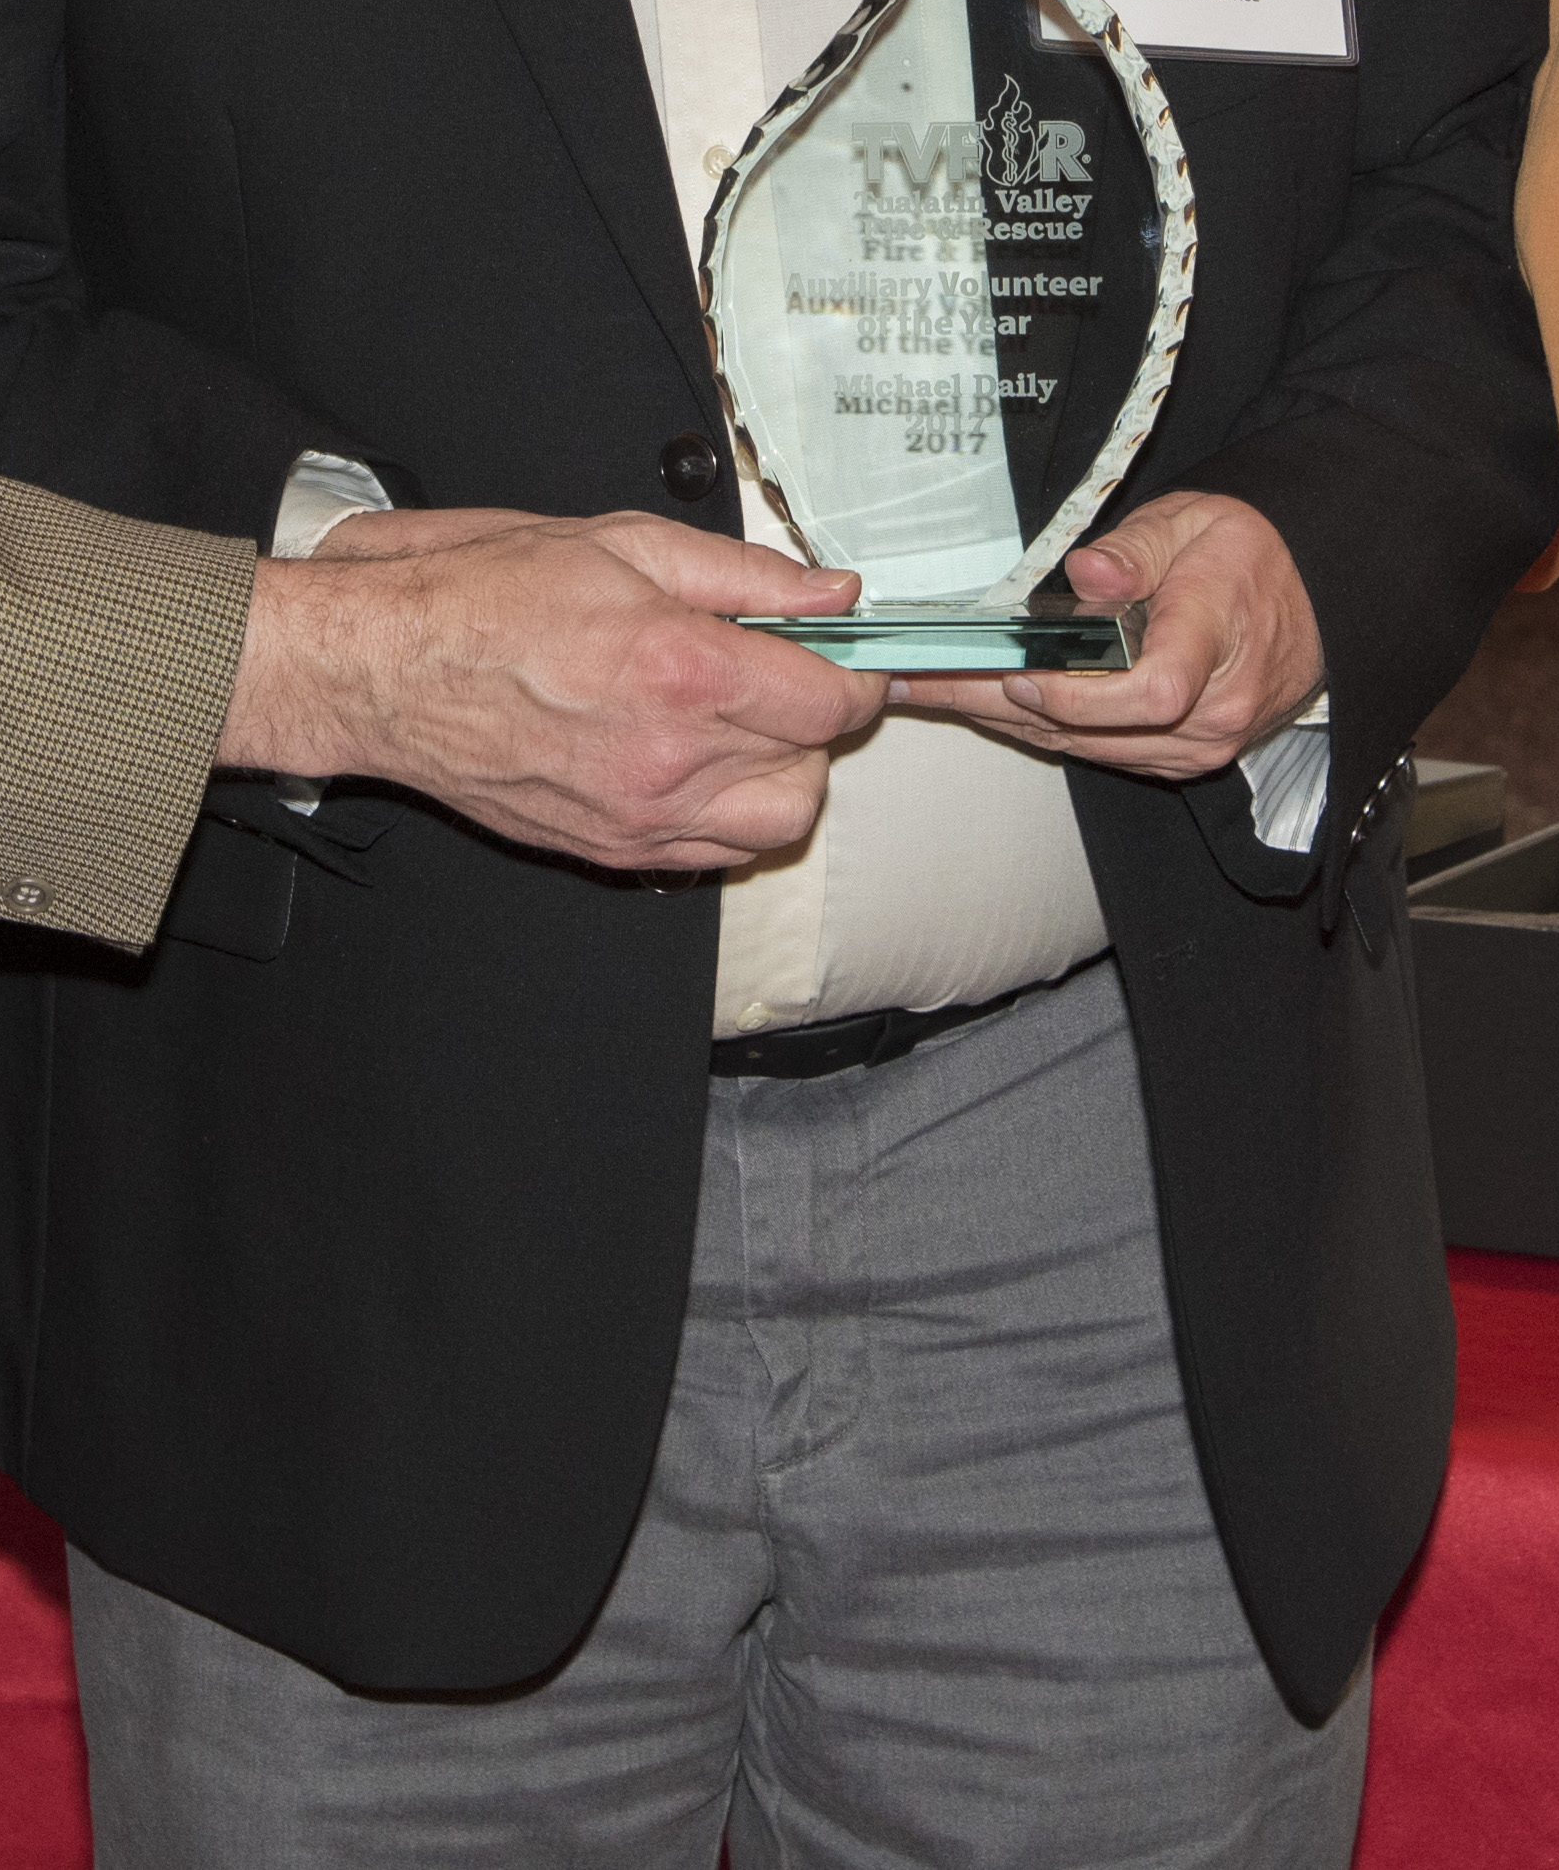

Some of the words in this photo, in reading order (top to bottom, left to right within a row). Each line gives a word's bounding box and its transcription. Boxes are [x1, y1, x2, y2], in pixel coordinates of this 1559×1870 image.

[853, 190, 988, 214] Tualatin
[995, 189, 1093, 219] Valley
[969, 217, 1084, 241] Rescue
[785, 271, 933, 303] Auxiliary
[938, 271, 1103, 297] Volunteer
[856, 312, 895, 335] of
[897, 310, 954, 335] the
[959, 310, 1032, 336] Year
[834, 373, 963, 398] Michael
[973, 372, 1058, 403] Daily
